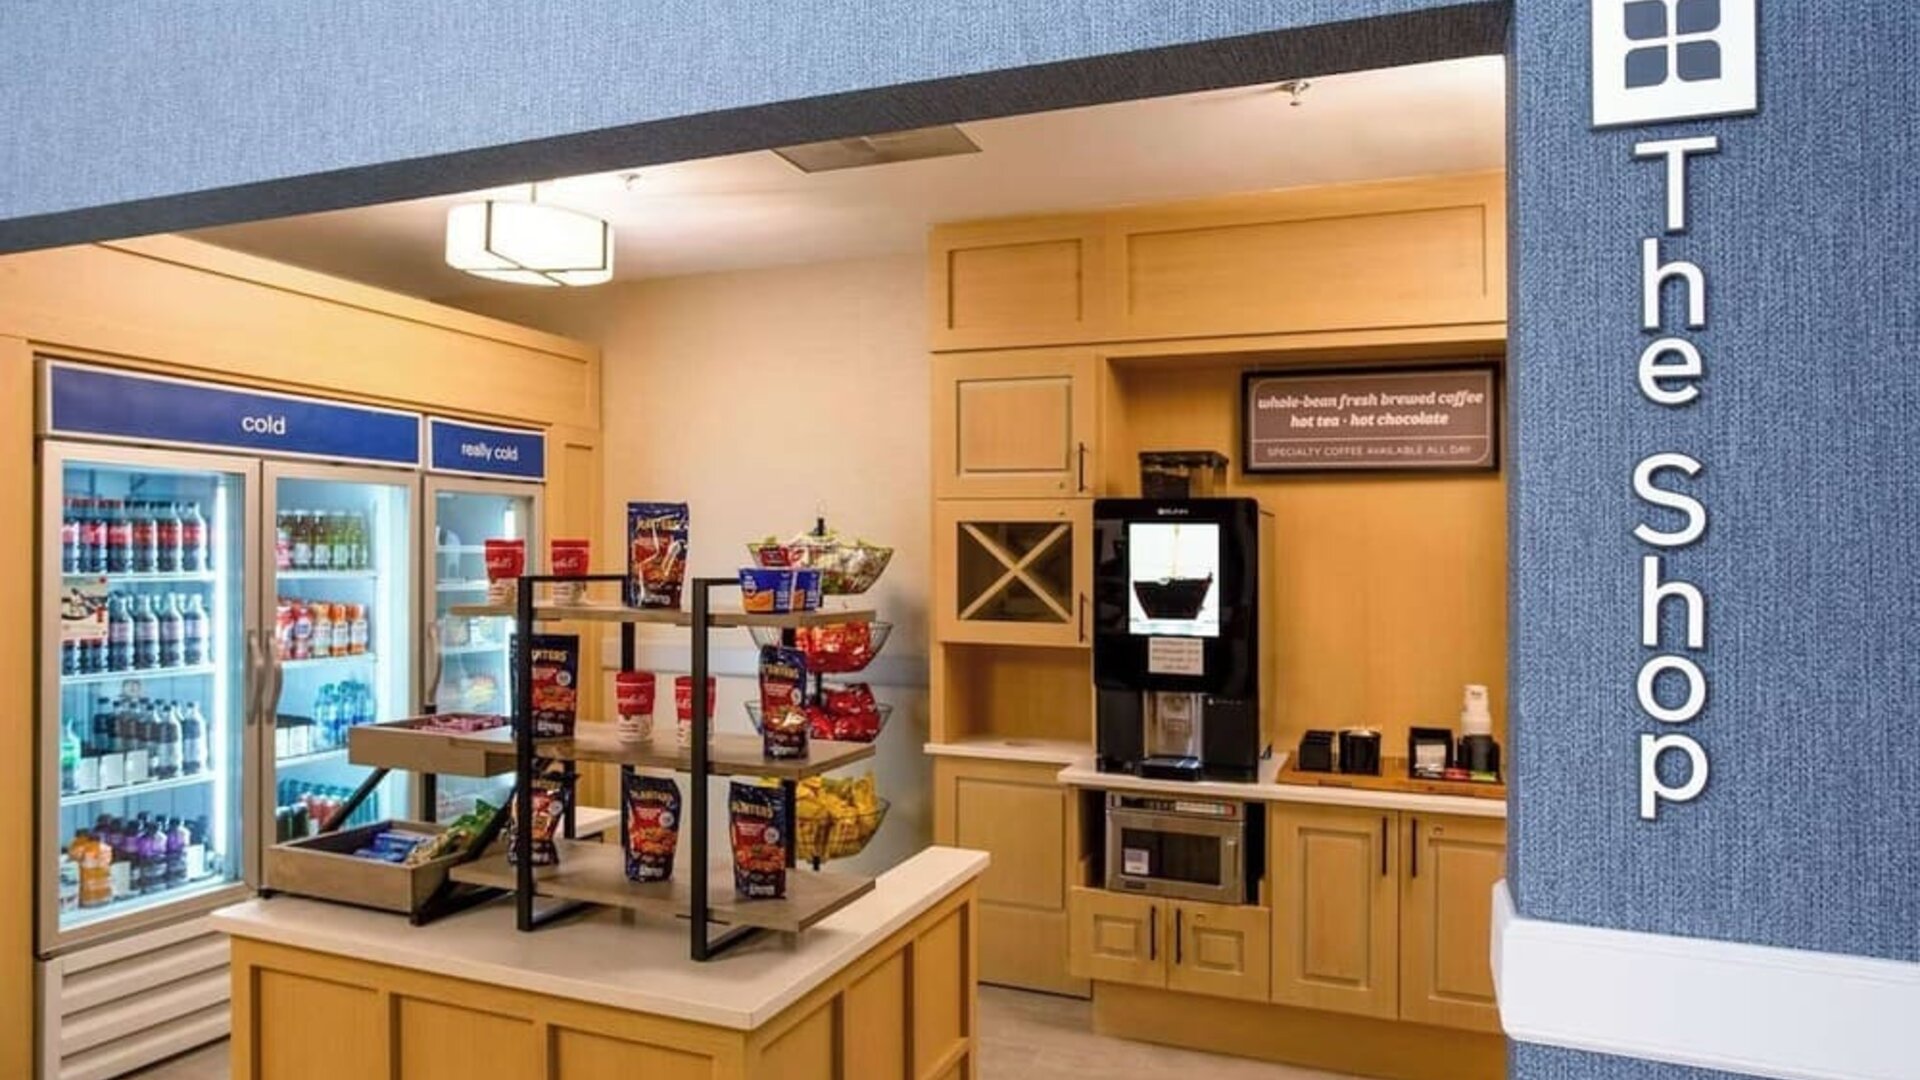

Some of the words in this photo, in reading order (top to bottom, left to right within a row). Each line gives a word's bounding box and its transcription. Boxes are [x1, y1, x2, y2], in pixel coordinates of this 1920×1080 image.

[1635, 136, 1717, 404] The
[1258, 395, 1336, 409] whole-bean
[1337, 392, 1378, 411] fresh
[1380, 390, 1435, 406] brewed
[1437, 389, 1484, 408] coffee
[241, 415, 286, 435] cold
[1290, 414, 1314, 428] hot
[1316, 414, 1339, 428] tea
[1350, 412, 1374, 427] hot
[1377, 411, 1449, 426] chocolate
[461, 442, 492, 462] really
[494, 446, 518, 462] cold
[1267, 446, 1321, 457] SPECIALTY
[1323, 446, 1362, 456] COFFEE
[1366, 445, 1423, 456] AVAILABLE
[1426, 445, 1446, 455] ALL
[1448, 444, 1471, 455] DAY
[1633, 452, 1709, 819] Shop
